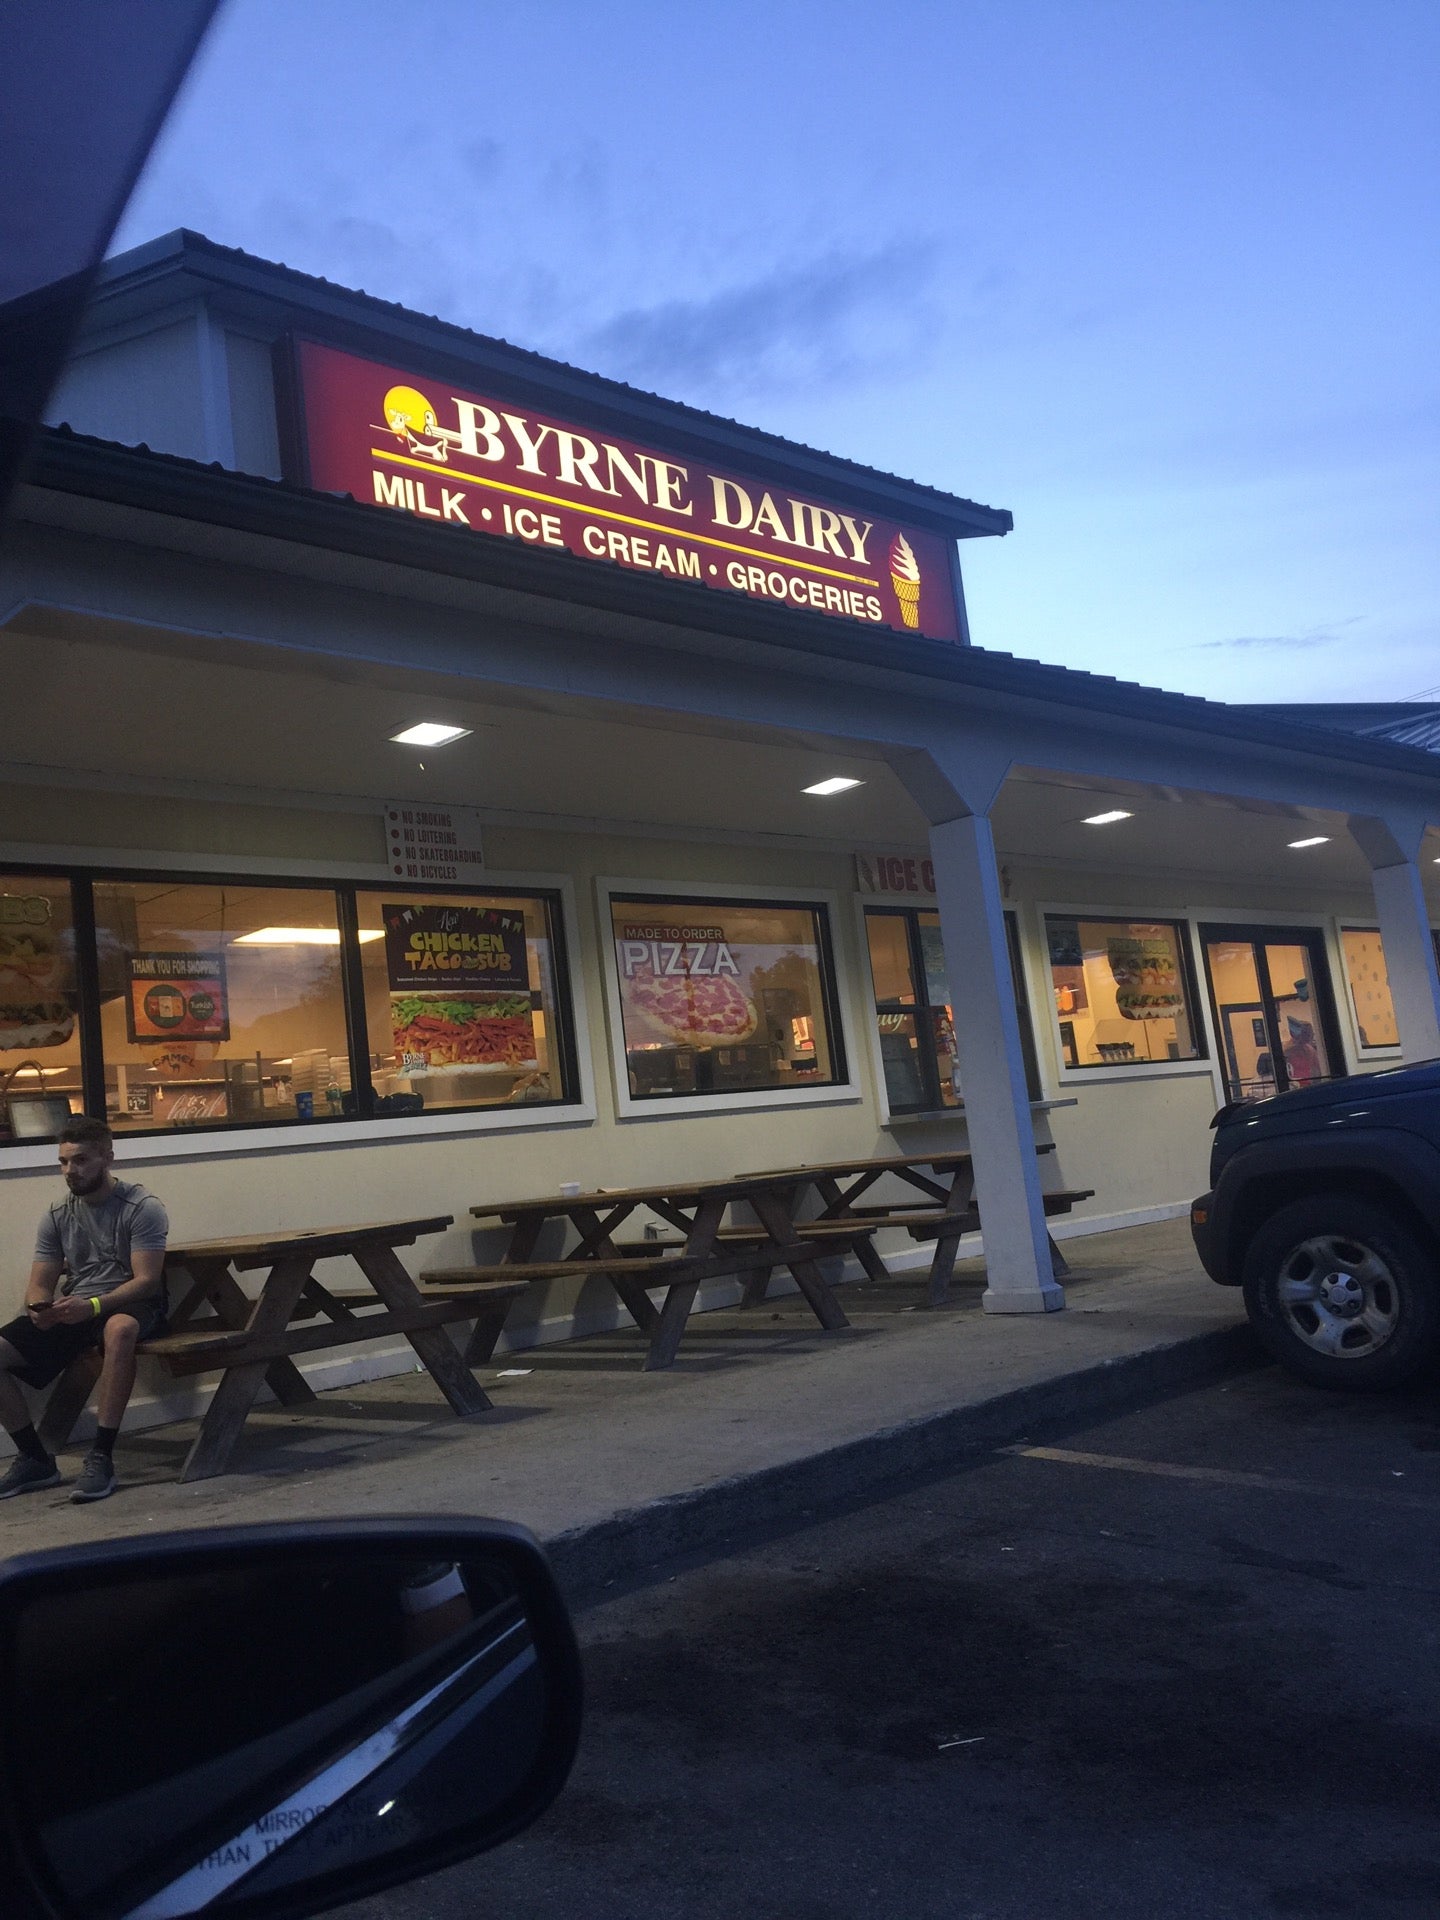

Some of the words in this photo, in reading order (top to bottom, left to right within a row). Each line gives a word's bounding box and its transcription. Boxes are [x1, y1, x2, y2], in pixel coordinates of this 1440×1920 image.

[451, 397, 694, 516] BYRNE
[708, 473, 873, 565] DAIRY
[372, 470, 470, 525] MILK
[503, 504, 564, 547] ICE
[583, 525, 702, 580] CREAM
[726, 561, 883, 622] GROCERIES
[402, 810, 414, 824] NO
[417, 811, 452, 827] SMOKING
[404, 829, 415, 842] NO
[418, 830, 457, 845] LOITERING
[405, 847, 416, 860] NO
[420, 847, 482, 864] SKATEBOARDING
[407, 864, 418, 878] NO
[421, 865, 458, 880] BICYCLES
[876, 856, 918, 892] ICE
[626, 927, 661, 940] MADE
[664, 928, 680, 940] TO
[682, 927, 723, 940] ORDER
[410, 931, 506, 954] CHICKEN
[131, 959, 156, 974] THANK
[157, 960, 171, 974] YOU
[173, 960, 186, 975] FOR
[405, 952, 462, 972] TACO
[478, 953, 512, 971] SUB
[623, 940, 741, 977] PIZZA
[152, 1053, 195, 1067] CAMEL
